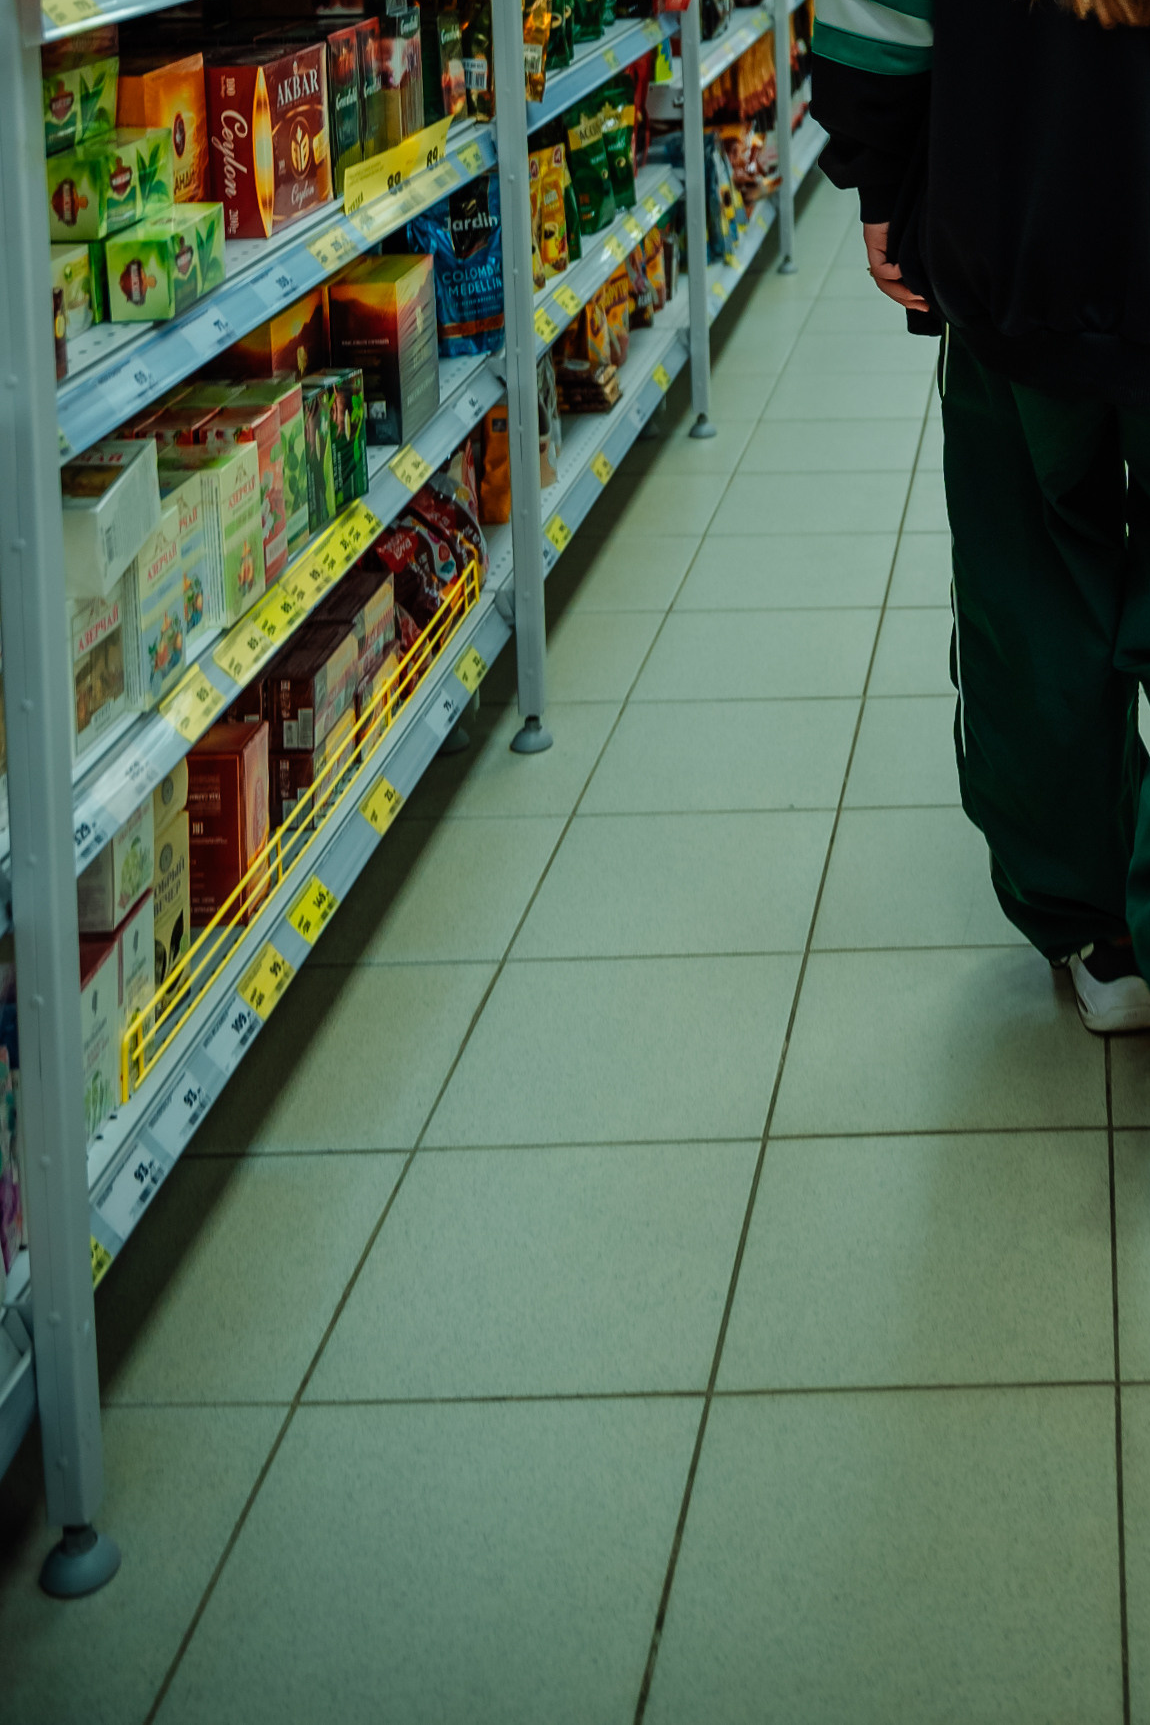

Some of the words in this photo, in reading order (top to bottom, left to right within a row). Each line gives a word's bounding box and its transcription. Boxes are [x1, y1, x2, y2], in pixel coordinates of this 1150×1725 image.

[276, 68, 319, 107] AKBAR
[211, 109, 249, 200] Ceylon
[290, 183, 316, 209] Ceylon
[443, 211, 499, 235] Jardin
[227, 478, 257, 510] АЗЕРЧАЙ
[147, 544, 178, 582] АЗЕРЧАЙ
[77, 604, 120, 653] АЗЕРЧАЙ
